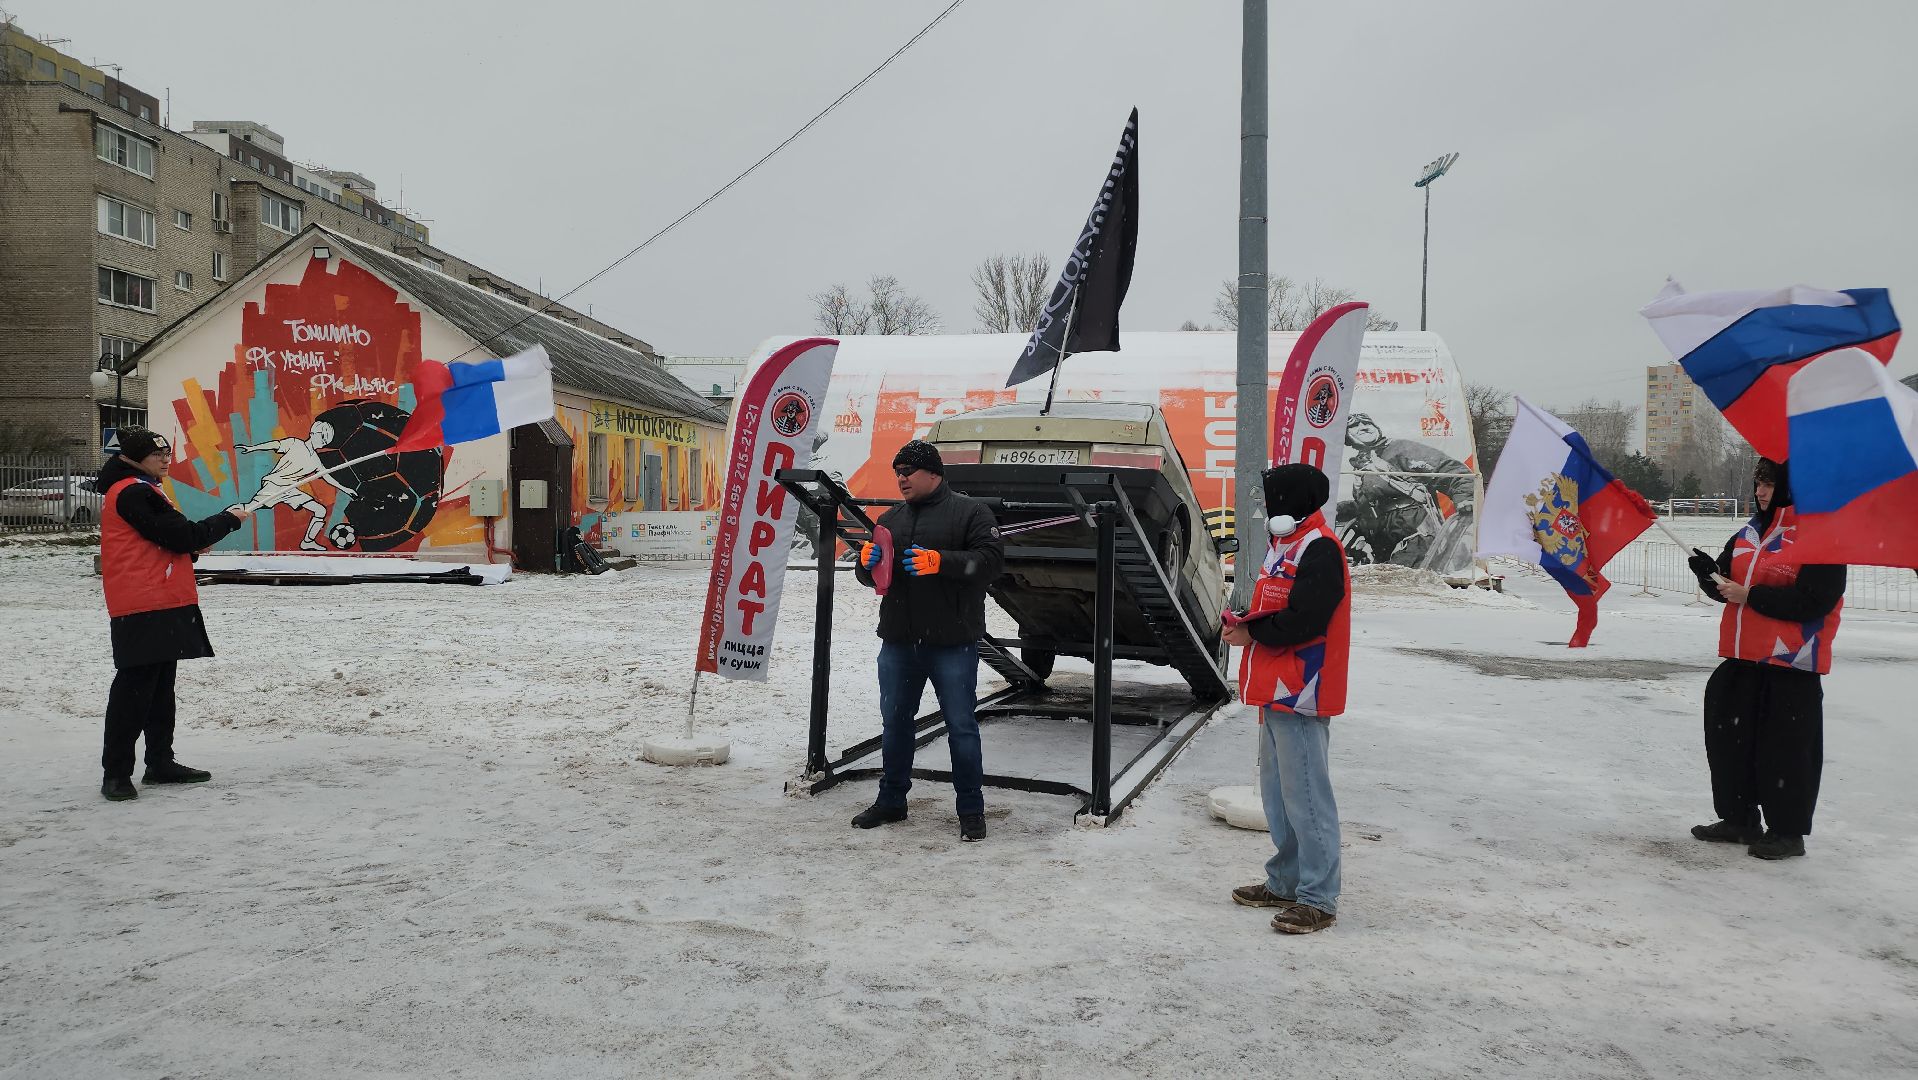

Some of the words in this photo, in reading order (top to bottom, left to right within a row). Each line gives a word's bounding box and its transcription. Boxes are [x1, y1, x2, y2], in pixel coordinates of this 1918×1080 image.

[616, 408, 684, 443] МОТОКРОСС
[734, 404, 760, 481] 215-21-21
[730, 483, 742, 512] 495
[726, 515, 737, 526] 8
[738, 441, 796, 636] ПИРАТ
